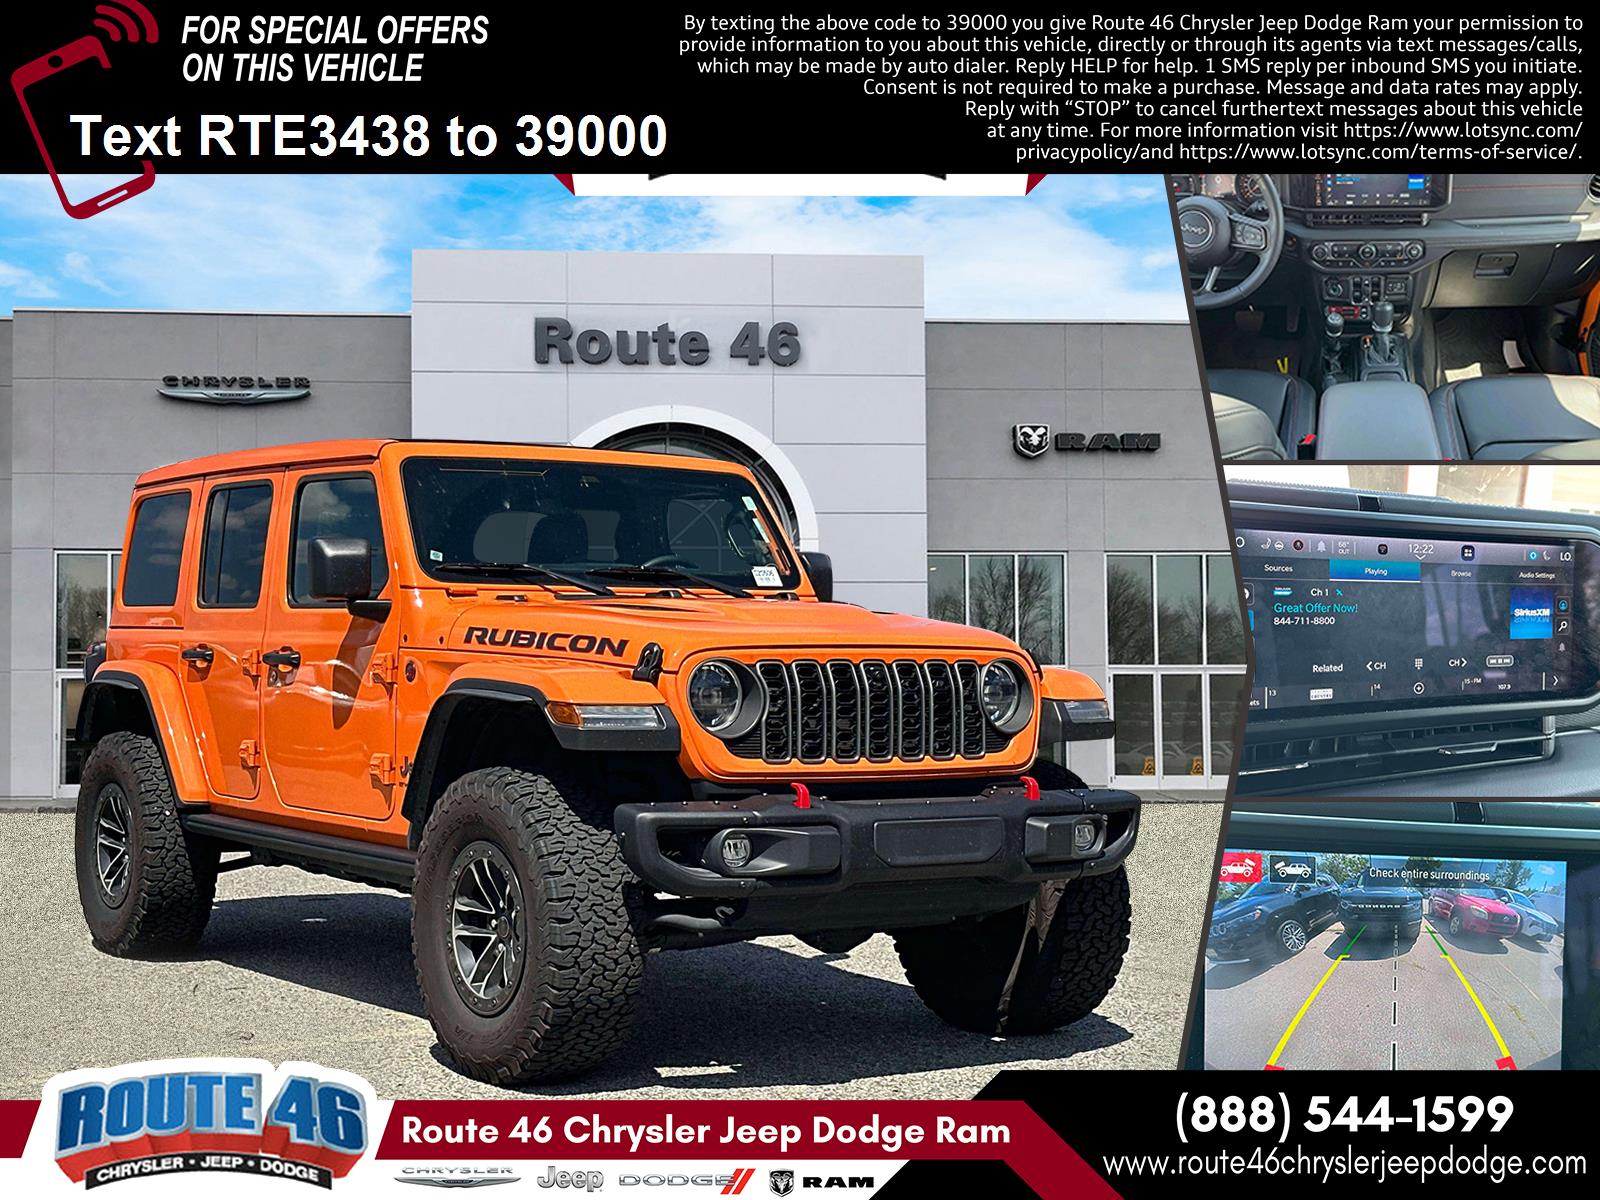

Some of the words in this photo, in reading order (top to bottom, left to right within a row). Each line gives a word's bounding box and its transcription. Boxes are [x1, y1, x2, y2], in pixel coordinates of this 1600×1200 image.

[534, 317, 710, 365] Route
[730, 321, 801, 367] 46
[162, 375, 311, 388] CHRYSLER
[1054, 433, 1161, 452] RAM
[1409, 544, 1434, 554] 12:22
[1560, 552, 1571, 561] LO
[1264, 564, 1293, 573] Sources
[1364, 567, 1388, 577] Playing
[1451, 570, 1472, 578] Browse
[1519, 571, 1534, 579] Audio
[1535, 572, 1556, 580] Settings
[1311, 588, 1323, 596] Ch
[1325, 588, 1329, 596] 1
[1273, 603, 1303, 613] Great
[1305, 603, 1330, 613] Offer
[1333, 603, 1359, 613] Now!
[1514, 608, 1550, 617] SiriusXM
[1273, 617, 1336, 625] 844-711-8800
[463, 626, 629, 657] RUBICON
[1373, 662, 1387, 670] CH
[1448, 659, 1460, 667] CH
[1312, 663, 1344, 673] Related
[1369, 867, 1399, 878] Check
[1401, 868, 1429, 879] entire
[1430, 869, 1490, 883] surroundings
